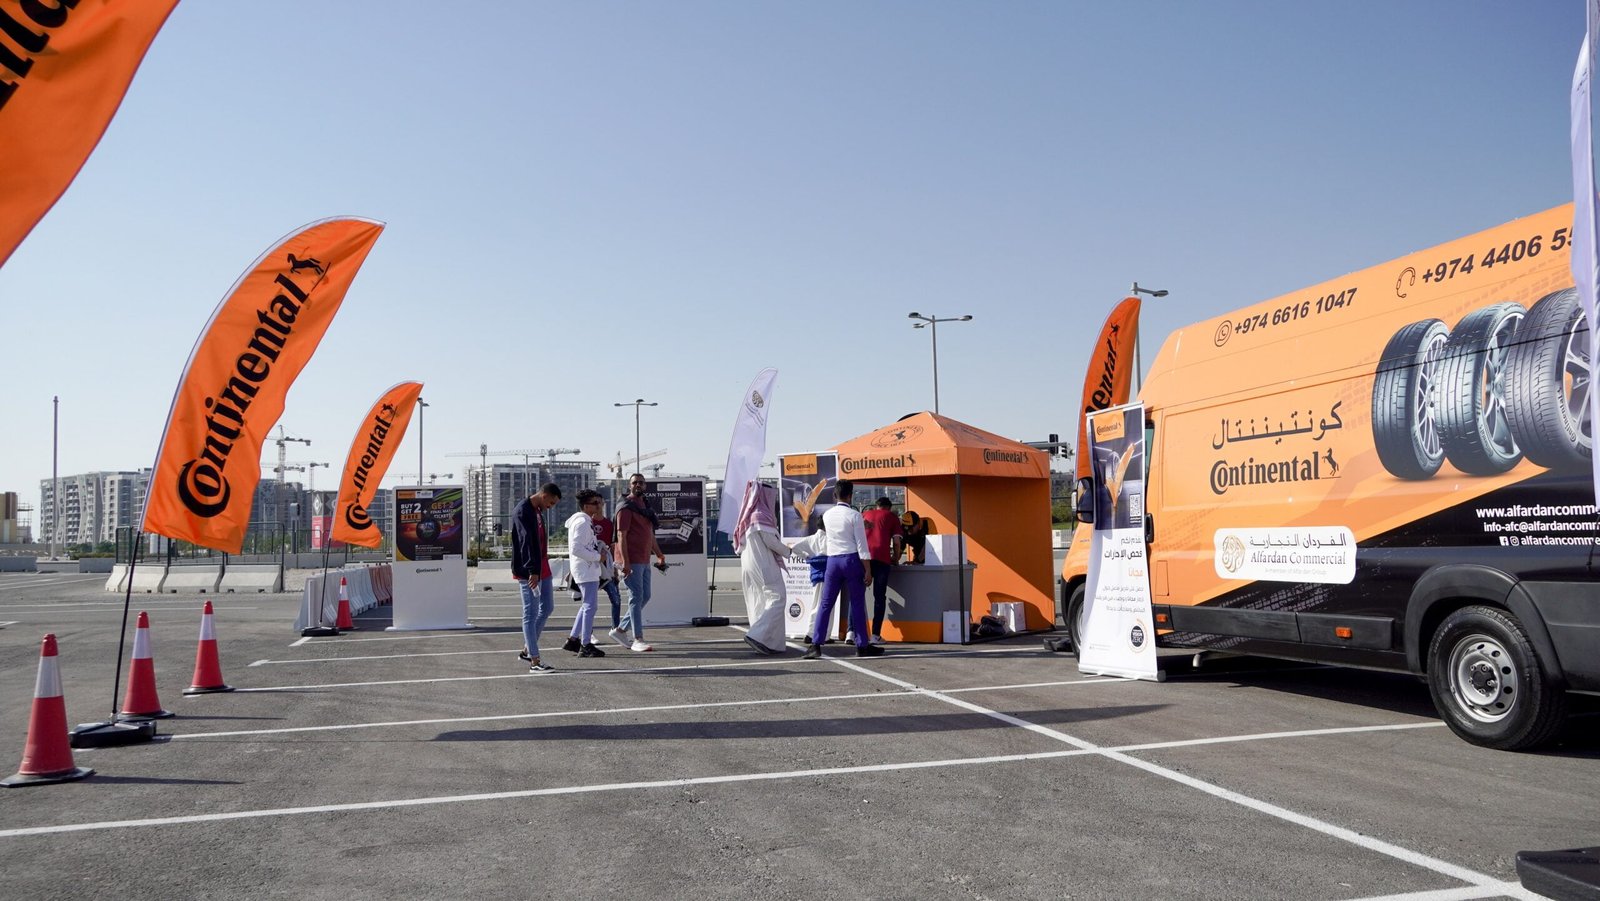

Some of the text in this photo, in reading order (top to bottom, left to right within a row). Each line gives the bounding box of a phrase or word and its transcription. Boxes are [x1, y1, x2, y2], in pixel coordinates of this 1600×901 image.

[1422, 254, 1475, 283] +974
[1481, 235, 1543, 268] 4406
[1234, 287, 1358, 334] +974 6616 1047
[176, 273, 310, 518] Continental
[1097, 422, 1118, 436] Continental
[1212, 400, 1343, 450] كونتيننتال
[840, 454, 905, 474] Continental
[983, 448, 1023, 464] Continental
[786, 463, 811, 471] Continental
[1210, 451, 1320, 495] Continental
[414, 503, 421, 513] 2
[431, 502, 448, 510] GET
[1250, 550, 1346, 565] Alfardan Commercial
